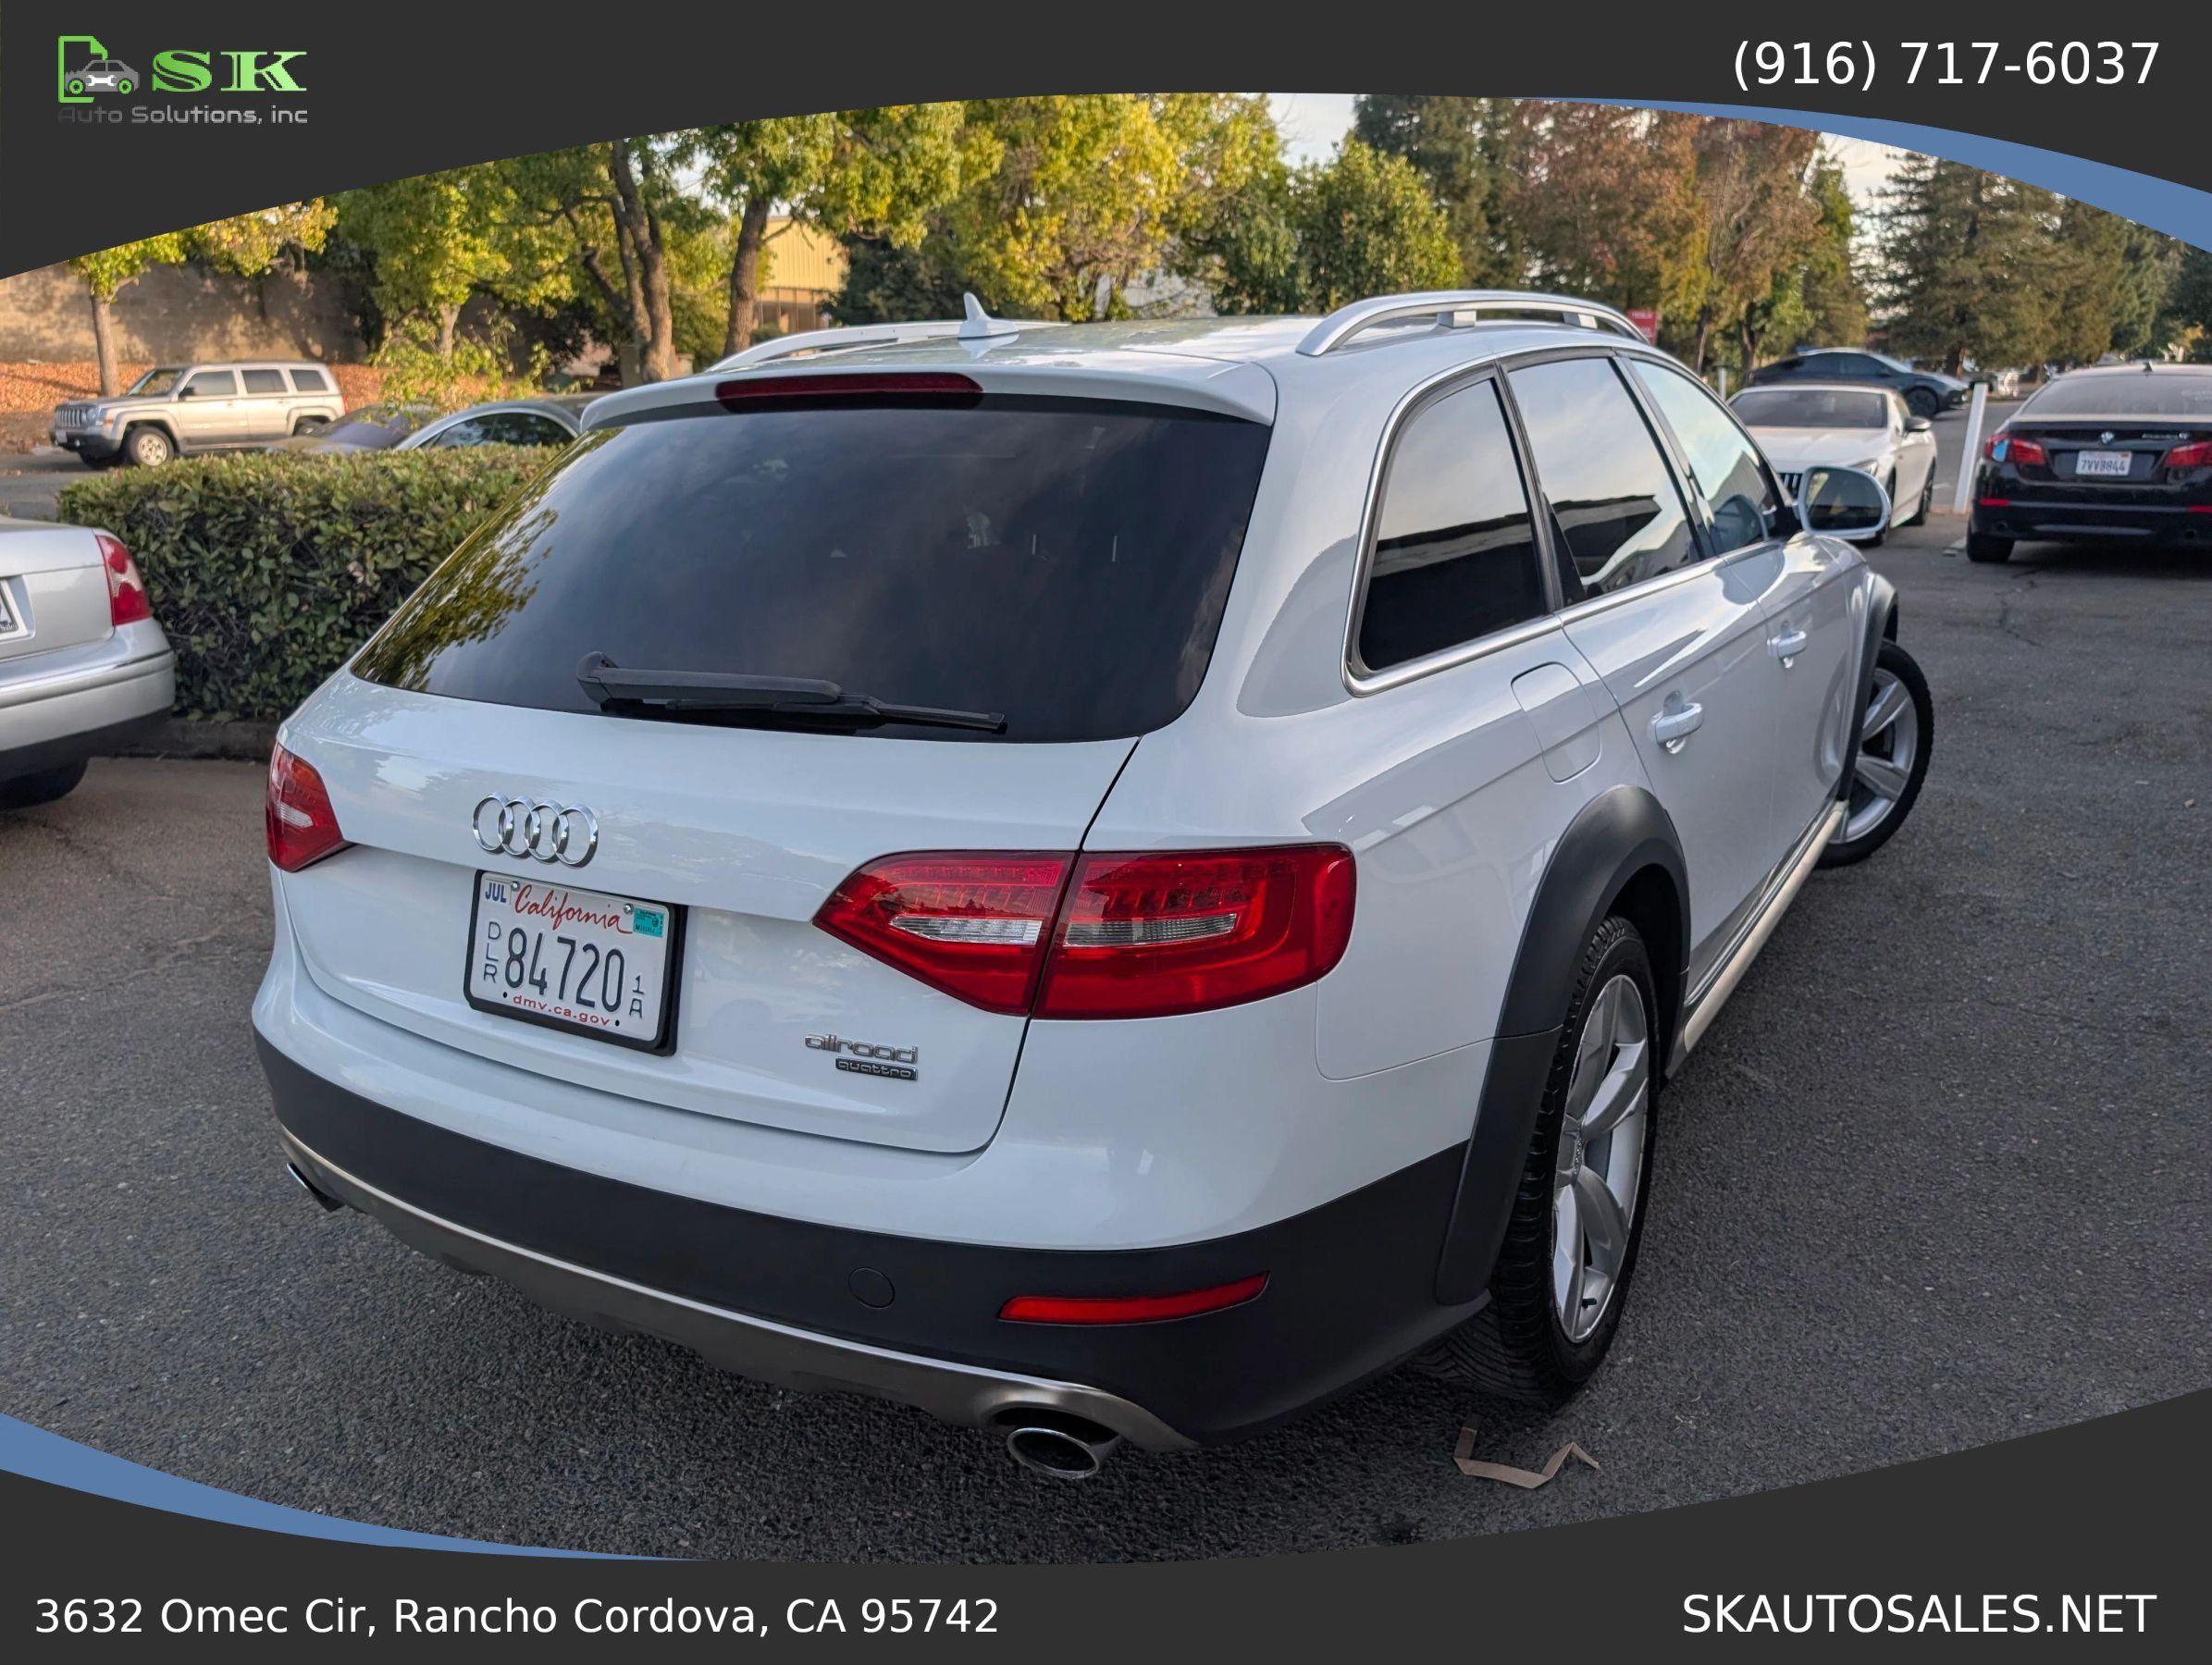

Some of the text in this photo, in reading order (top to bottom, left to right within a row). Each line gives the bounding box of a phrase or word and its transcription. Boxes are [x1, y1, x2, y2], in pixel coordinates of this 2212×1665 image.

[485, 882, 507, 904] JUL
[514, 884, 633, 933] California
[505, 927, 625, 1013] 84720
[804, 1034, 919, 1064] allroad
[837, 1061, 912, 1079] quattro
